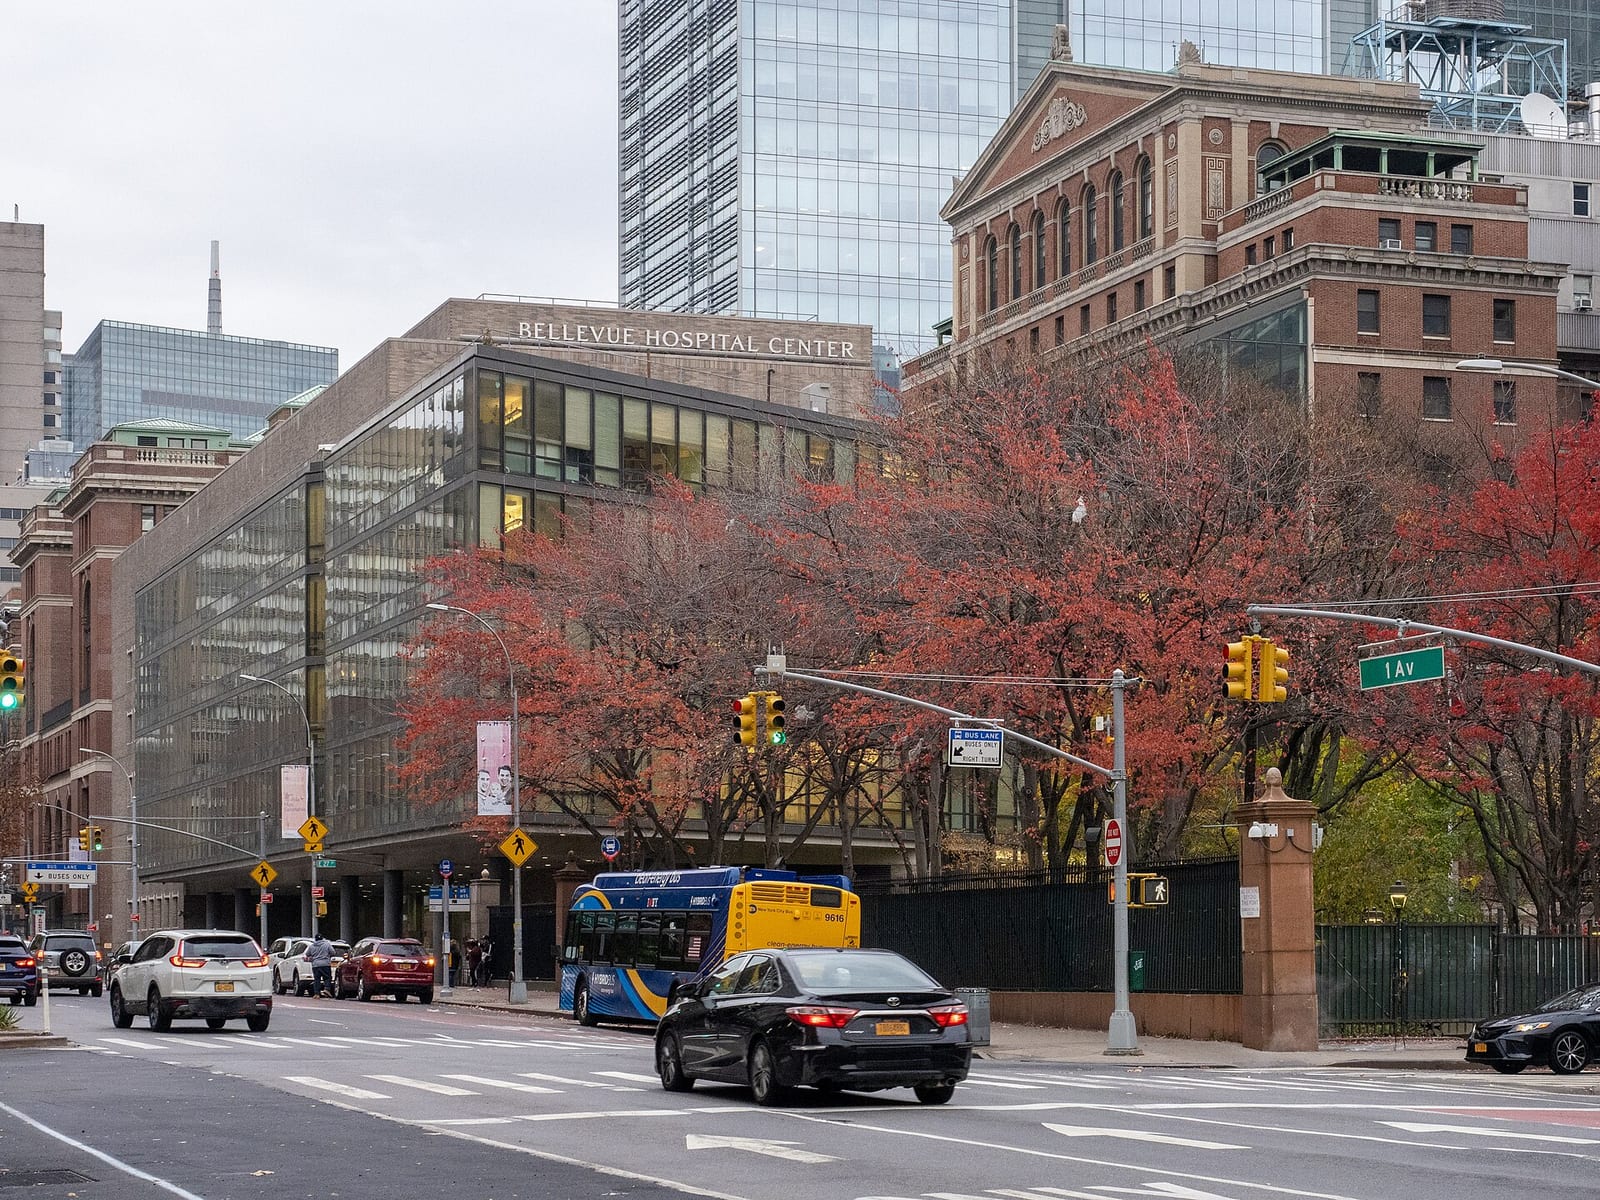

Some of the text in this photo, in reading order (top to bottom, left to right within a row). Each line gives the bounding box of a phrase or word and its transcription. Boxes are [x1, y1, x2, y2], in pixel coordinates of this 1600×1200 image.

[519, 322, 854, 358] BELLEVUE HOSPITAL CENTER
[1385, 660, 1414, 680] 1 Av
[964, 731, 999, 740] BUS LANE
[1108, 848, 1119, 857] ENTER
[824, 913, 845, 923] 9616
